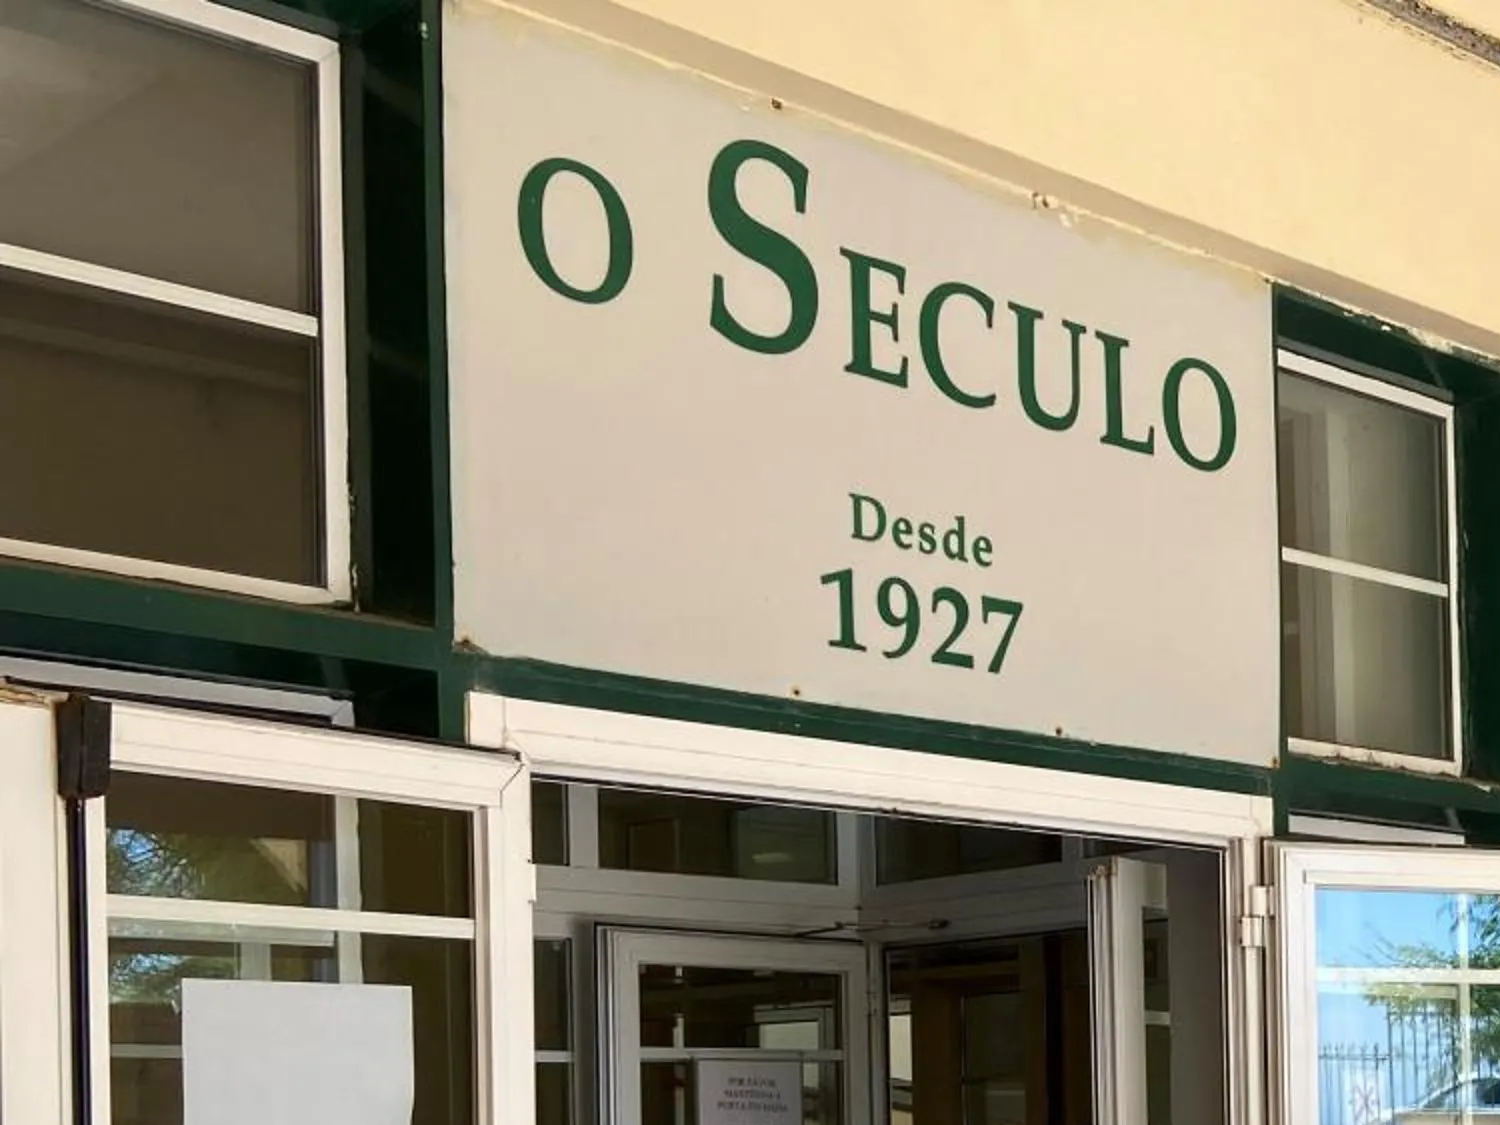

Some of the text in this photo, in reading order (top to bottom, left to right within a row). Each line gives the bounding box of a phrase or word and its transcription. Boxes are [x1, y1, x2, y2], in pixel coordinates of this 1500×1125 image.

[517, 157, 633, 305] O
[848, 492, 995, 567] Desde
[820, 568, 1024, 674] 1927
